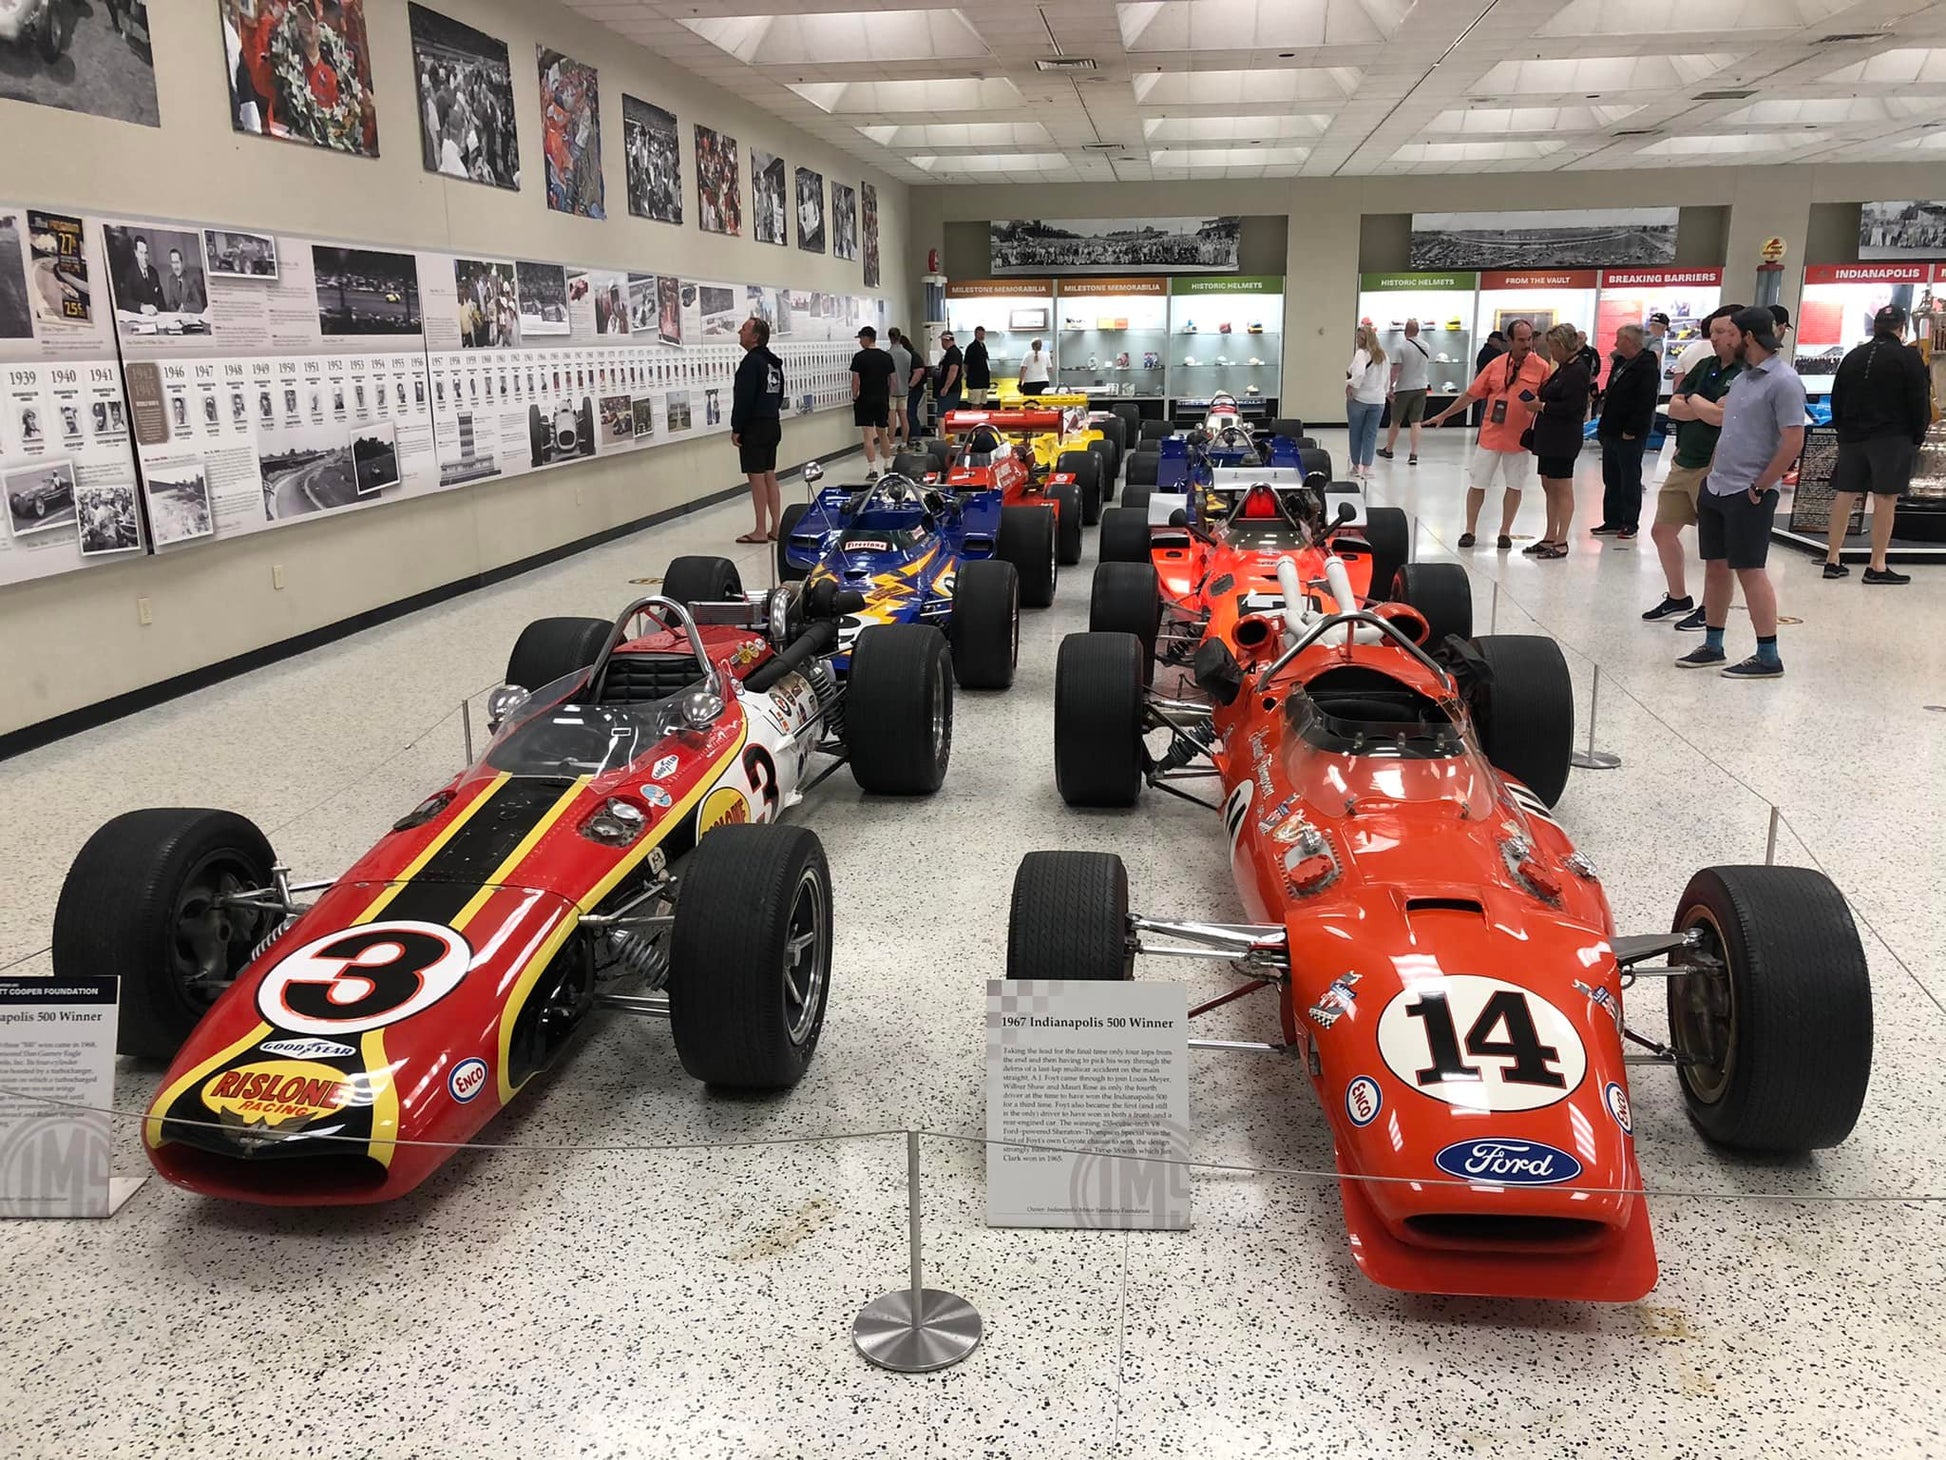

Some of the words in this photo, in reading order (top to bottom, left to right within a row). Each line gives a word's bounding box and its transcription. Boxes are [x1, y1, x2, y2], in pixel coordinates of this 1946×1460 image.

[1608, 274, 1662, 284] BREAKING
[1664, 273, 1717, 282] BARRIERS
[1835, 268, 1921, 279] INDIANAPOLIS
[1191, 282, 1226, 290] HISTORIC
[1380, 279, 1417, 287] HISTORIC
[1418, 278, 1455, 286] HELMETS
[1546, 276, 1571, 284] VAULT
[993, 285, 1046, 293] MEMORABILIA
[224, 364, 243, 376] 1948
[252, 363, 270, 375] 1949
[279, 362, 296, 373] 1950
[303, 361, 320, 373] 1951
[327, 360, 343, 371] 1952
[350, 359, 365, 370] 1953
[371, 359, 386, 370] 1954
[10, 370, 37, 385] 1939
[51, 369, 77, 384] 1940
[90, 368, 113, 381] 1941
[164, 365, 186, 378] 1946
[195, 365, 214, 378] 1947
[846, 541, 886, 550] Firestone
[742, 743, 780, 824] 3
[280, 928, 451, 1023] 3
[9, 987, 43, 996] COOPER
[43, 987, 99, 996] FOUNDATION
[37, 1011, 56, 1022] 500
[59, 1010, 103, 1022] Winner
[1001, 1017, 1027, 1028] 1967
[1029, 1017, 1104, 1030] Indianapolis
[1106, 1017, 1126, 1028] 500
[1130, 1018, 1175, 1029] Winner
[1404, 990, 1568, 1090] 14
[262, 1041, 354, 1057] GOODYEAR
[1003, 1047, 1026, 1057] Taking
[455, 1067, 484, 1094] ENCO
[209, 1071, 351, 1110] RISLONE
[1032, 1091, 1043, 1099] the
[1350, 1082, 1372, 1119] ENCO
[238, 1101, 309, 1117] RACING
[1003, 1153, 1021, 1161] Clark
[1463, 1142, 1554, 1177] Ford
